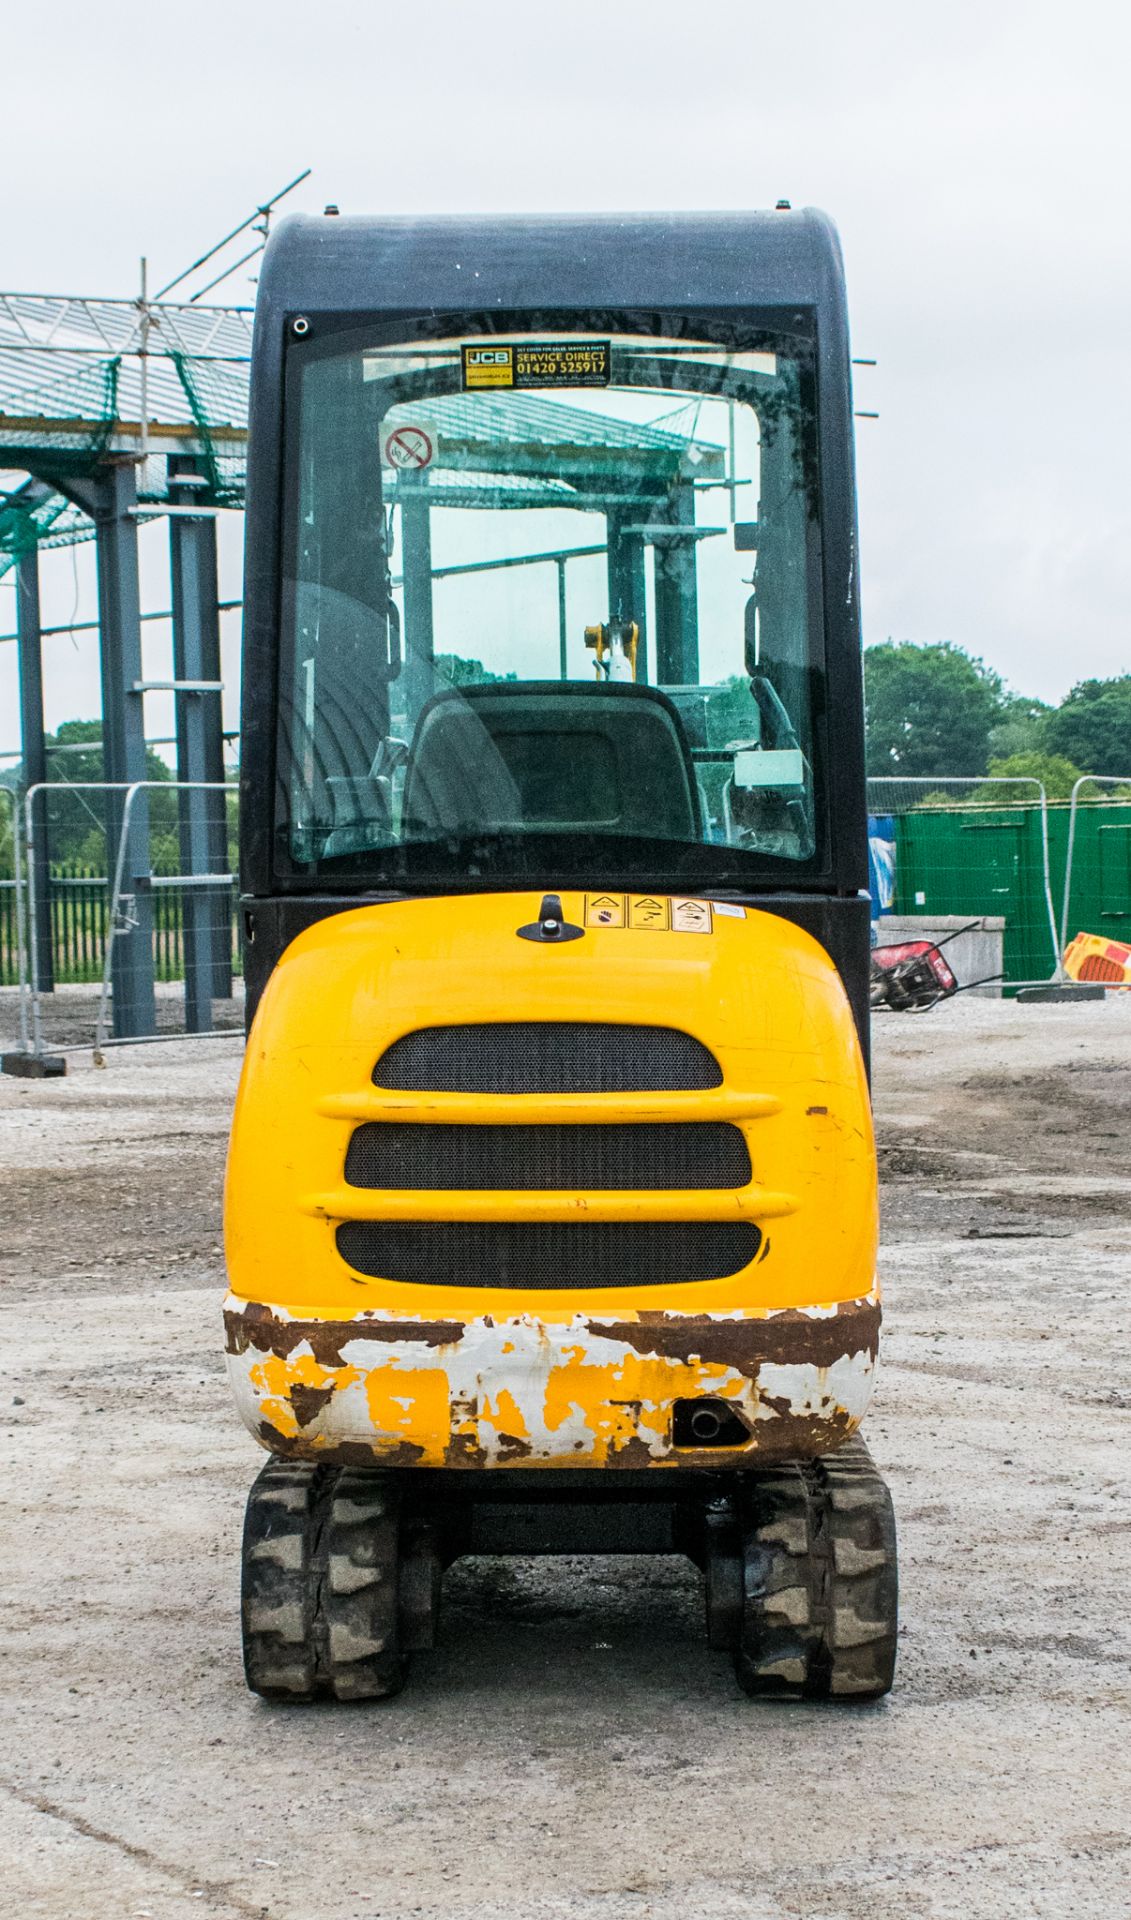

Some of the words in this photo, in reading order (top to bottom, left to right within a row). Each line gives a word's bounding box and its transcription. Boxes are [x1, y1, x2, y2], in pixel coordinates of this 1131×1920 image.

[470, 352, 508, 364] JCB
[517, 352, 562, 362] SERVICE
[565, 351, 604, 361] DIRECT
[517, 362, 556, 374] 01420
[560, 361, 605, 373] 525917
